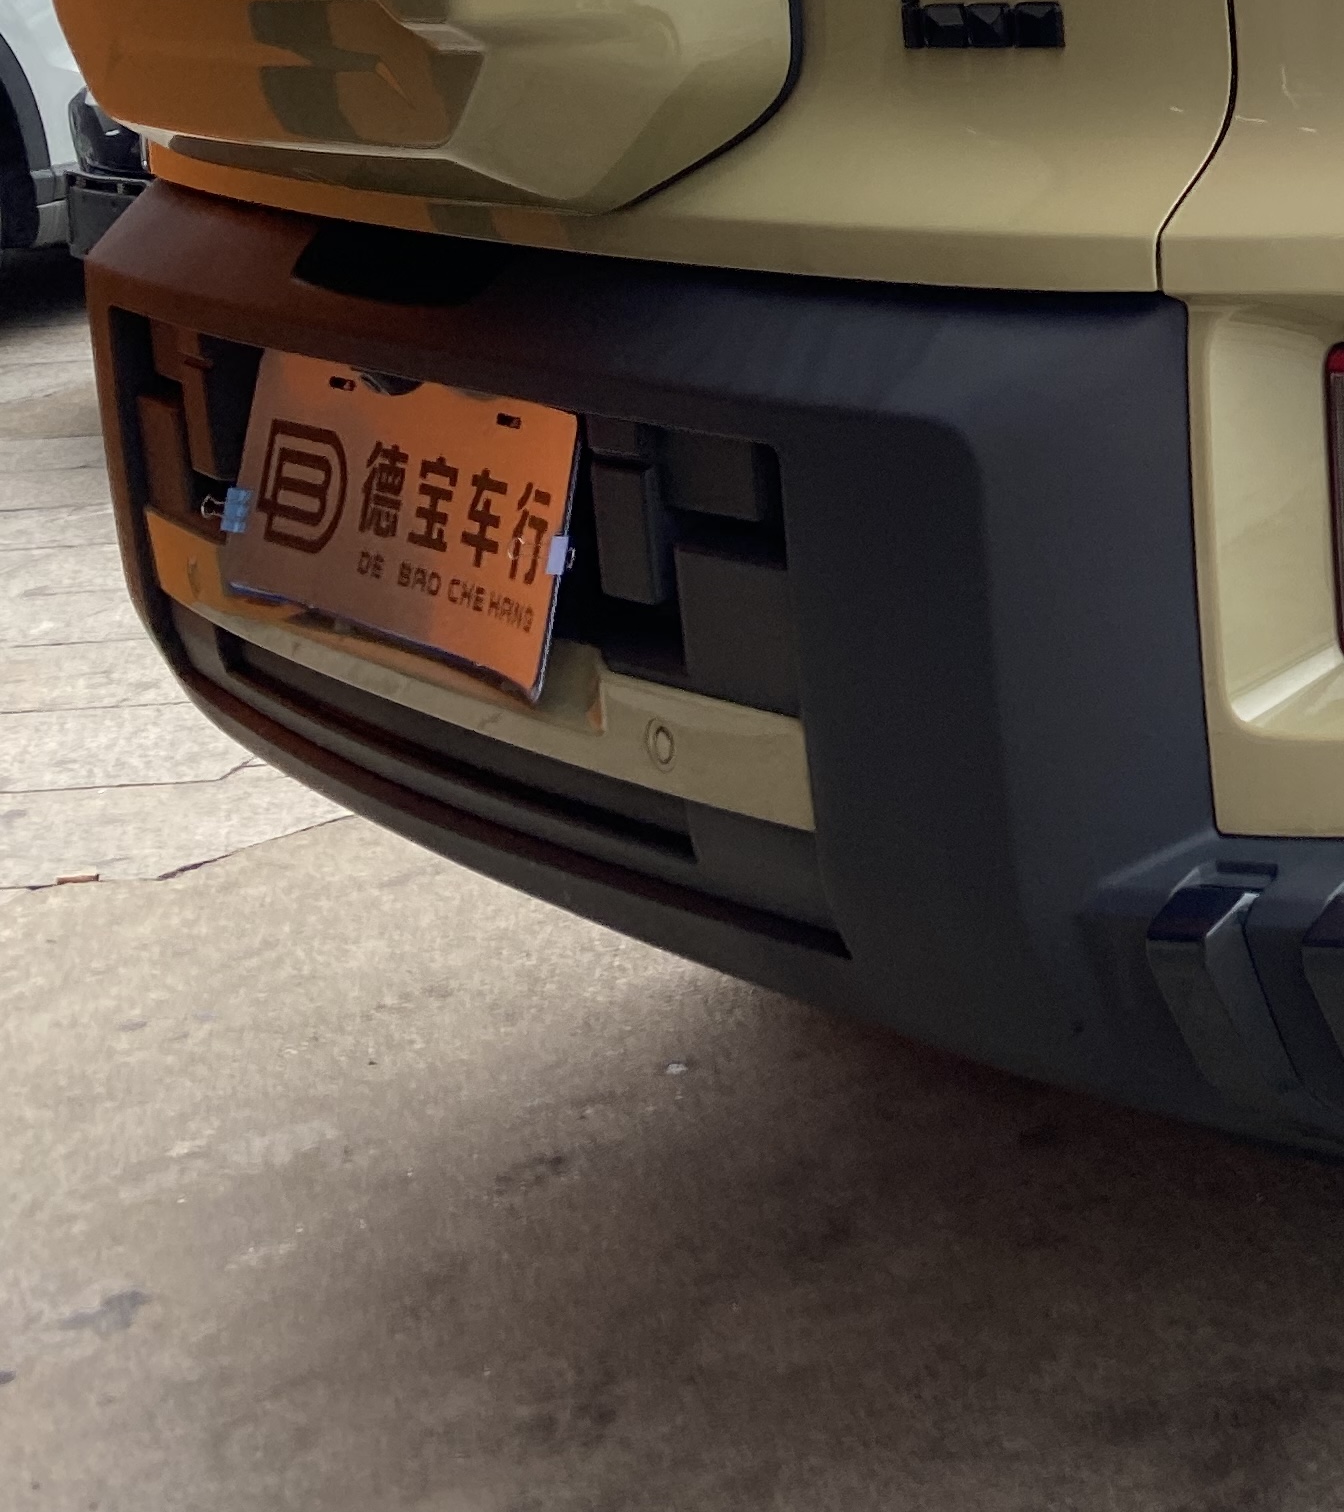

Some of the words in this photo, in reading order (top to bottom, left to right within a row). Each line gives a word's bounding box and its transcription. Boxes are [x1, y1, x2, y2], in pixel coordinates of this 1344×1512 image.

[358, 440, 551, 586] 德宝车行
[357, 551, 385, 579] DE
[397, 560, 442, 596] BAO
[447, 579, 486, 612] CHE
[488, 589, 535, 632] HANG
